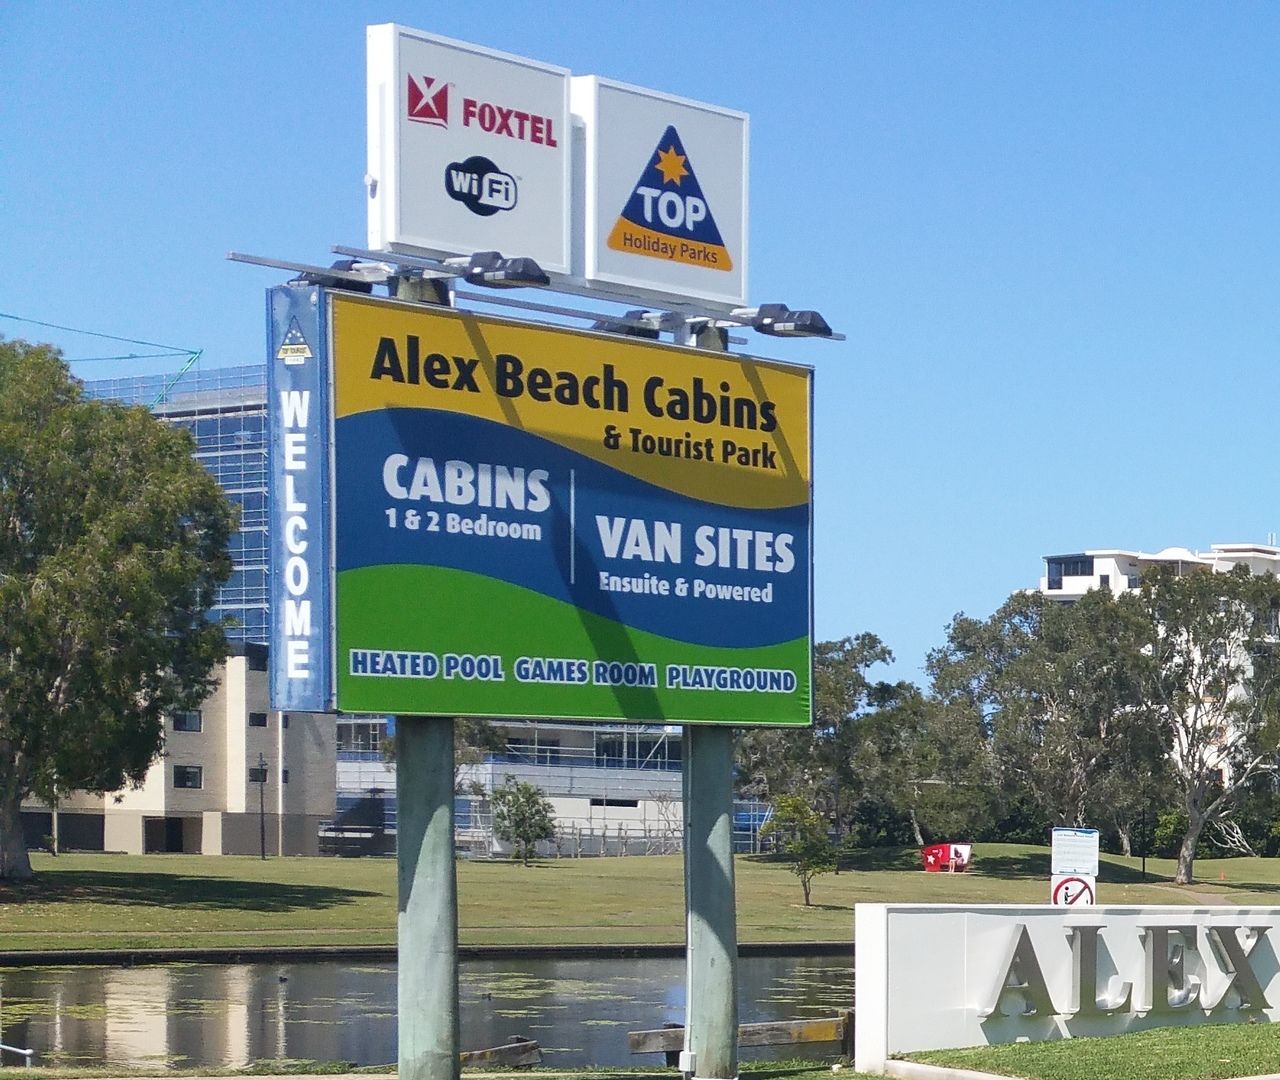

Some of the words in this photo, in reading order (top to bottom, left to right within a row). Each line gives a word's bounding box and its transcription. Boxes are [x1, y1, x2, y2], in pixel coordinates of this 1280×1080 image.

[463, 98, 557, 147] FOXTEL
[637, 186, 706, 231] TOP
[623, 232, 677, 258] Holiday
[680, 243, 718, 263] Parks
[369, 334, 480, 393] Alex
[495, 353, 629, 412] Beach
[643, 376, 777, 432] Cabins
[603, 425, 621, 449] &
[629, 427, 714, 462] Tourist
[722, 440, 777, 469] Park
[382, 453, 551, 513] CABINS
[280, 390, 311, 679] WELCOME
[385, 507, 397, 528] 1
[404, 509, 421, 530] &
[426, 511, 440, 532] 2
[446, 513, 542, 541] Bedroom
[595, 515, 682, 564] VAN
[694, 525, 796, 574] SITES
[599, 571, 670, 595] Ensuite
[675, 577, 689, 597] &
[693, 579, 773, 603] Powered
[351, 650, 438, 677] HEATED
[444, 655, 503, 680] POOL
[515, 658, 589, 684] GAMES
[594, 662, 656, 686] ROOM
[667, 665, 796, 692] PLAYGROUND
[977, 924, 1275, 1017] ALEX
